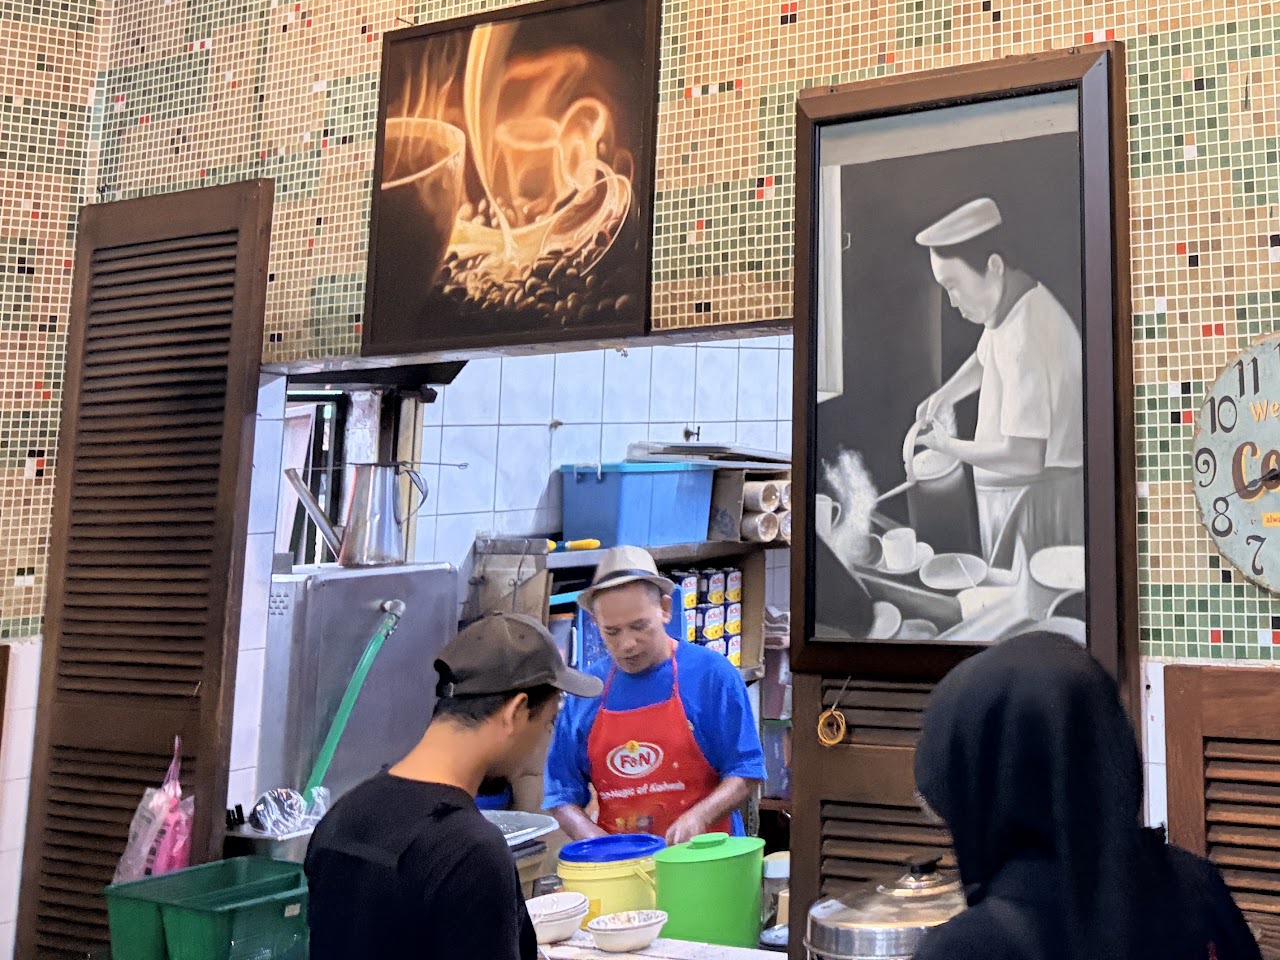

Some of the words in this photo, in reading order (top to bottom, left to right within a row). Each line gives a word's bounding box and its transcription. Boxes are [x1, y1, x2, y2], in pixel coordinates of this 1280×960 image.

[1233, 356, 1260, 397] 11
[1205, 395, 1238, 435] 10
[1250, 399, 1280, 422] We
[1195, 448, 1217, 488] 9
[1212, 497, 1233, 538] 8
[1246, 535, 1267, 576] 7
